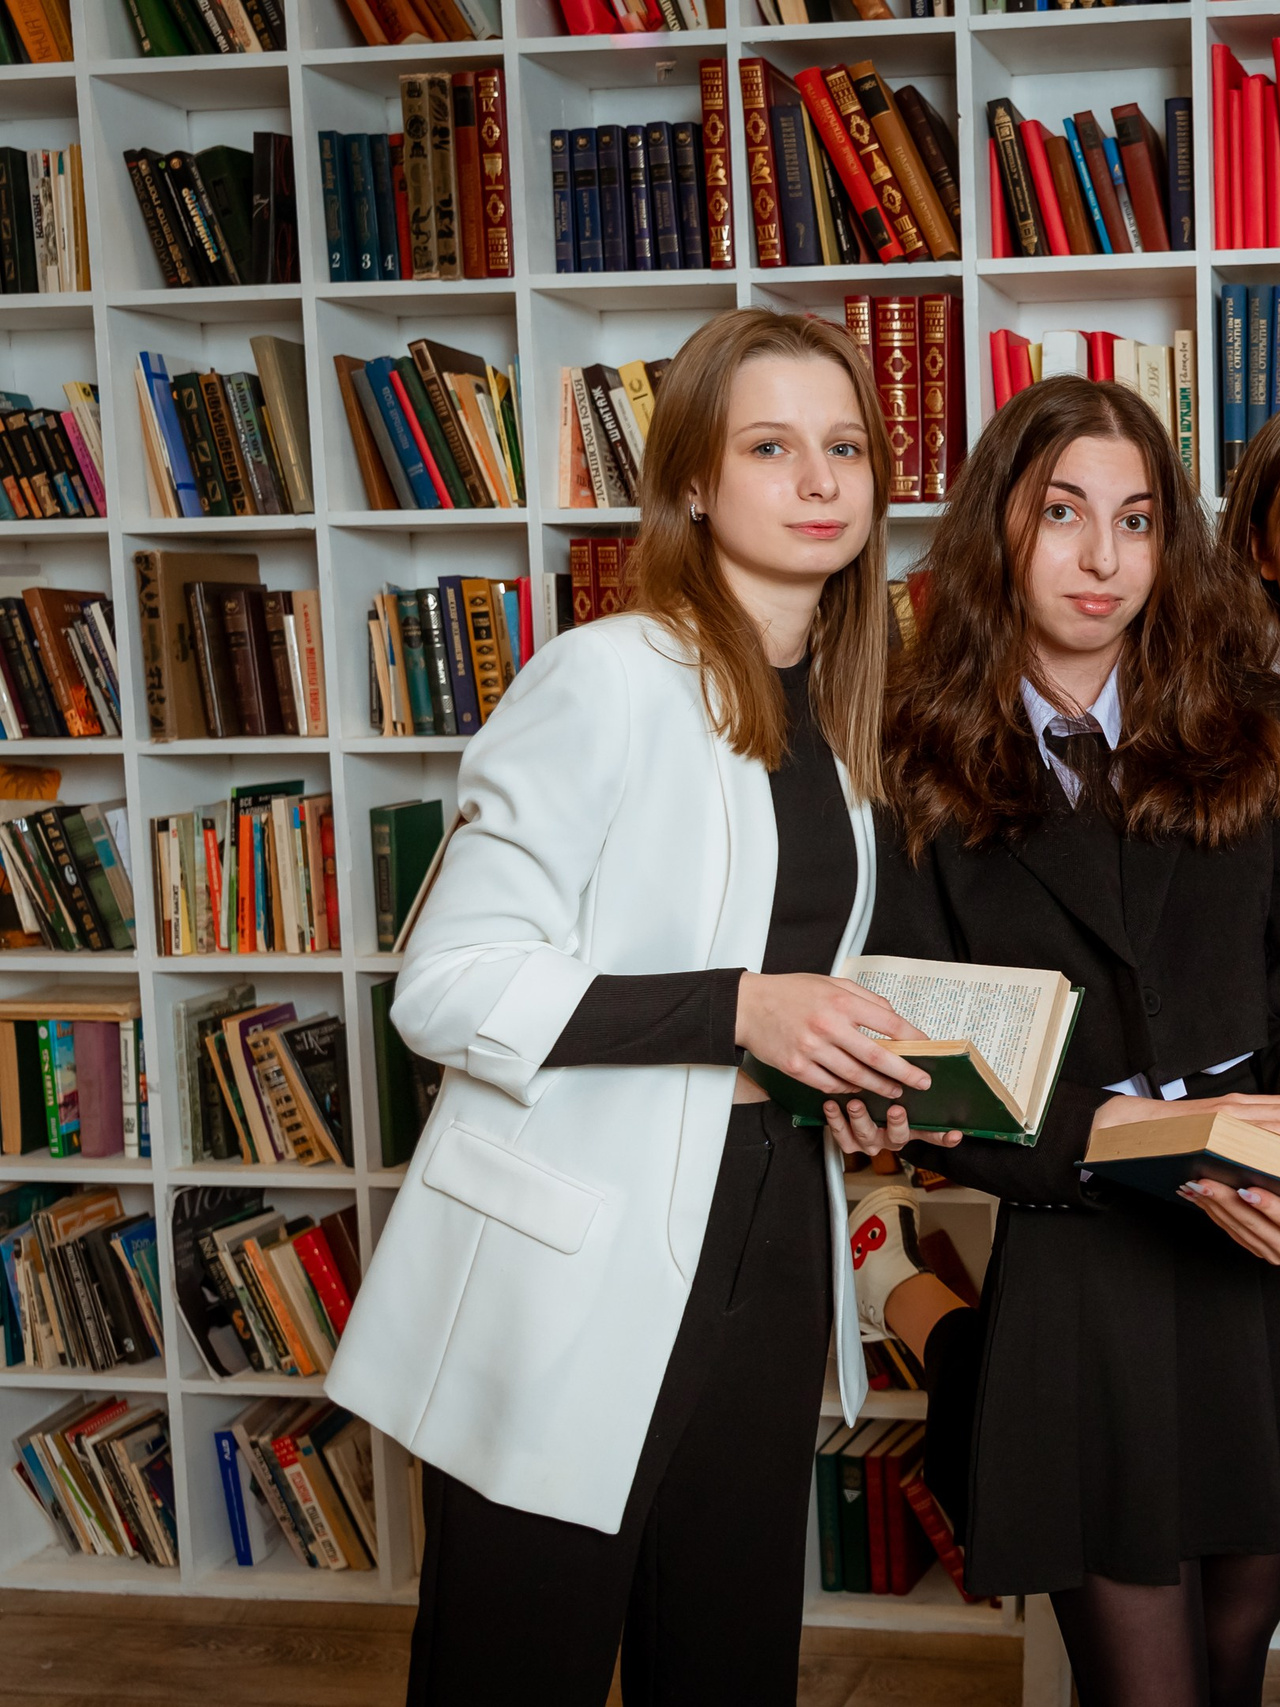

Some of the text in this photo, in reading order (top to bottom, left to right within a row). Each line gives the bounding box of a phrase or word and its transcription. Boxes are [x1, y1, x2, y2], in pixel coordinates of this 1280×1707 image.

[130, 168, 147, 199] ЭПОХА
[141, 201, 154, 217] ЕГО
[144, 175, 174, 242] ВИКТОР ГЮГО
[181, 185, 219, 262] РЕАНИМАТОР
[757, 224, 776, 239] XIV
[894, 215, 913, 233] VIII
[151, 228, 174, 275] ПЛАТОН
[710, 225, 729, 241] XIV
[332, 252, 341, 268] 2
[362, 253, 371, 269] 3
[384, 253, 394, 270] 4
[1233, 318, 1241, 368] ОТКРЫТИЯ
[1258, 318, 1266, 404] НОВЫЕ ОТКРЫТИЯ
[1226, 345, 1234, 403] ПАМЯТНИКИ
[1250, 346, 1258, 404] ПАМЯТНИКИ
[592, 385, 618, 442] ШАНТАЖ
[1179, 387, 1190, 431] ШУКШИН
[573, 378, 606, 500] ЛАТЫШСКАЯ КУХНЯ
[42, 811, 69, 865] ВЕРН
